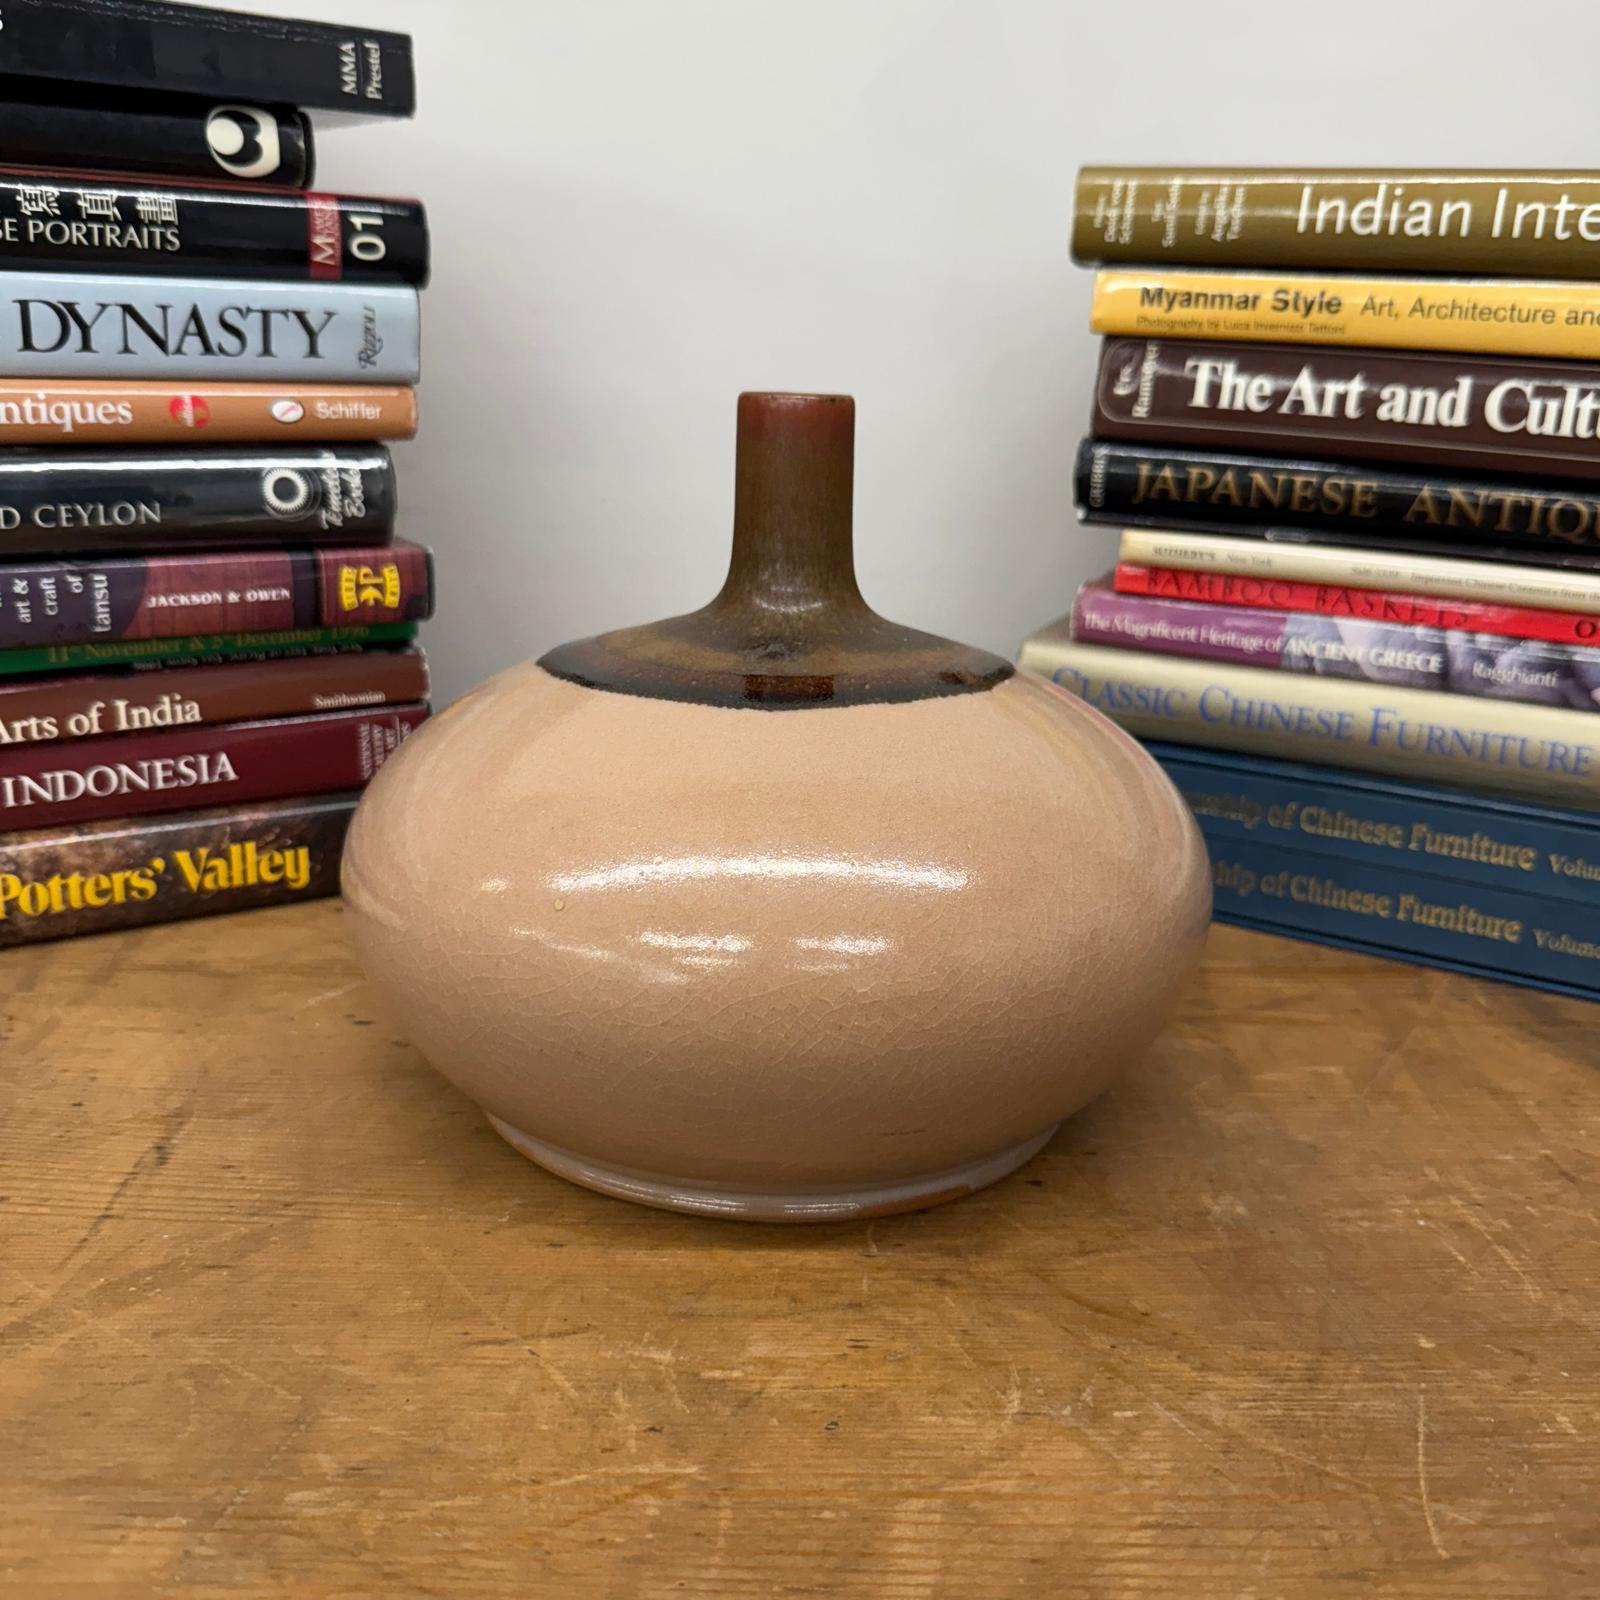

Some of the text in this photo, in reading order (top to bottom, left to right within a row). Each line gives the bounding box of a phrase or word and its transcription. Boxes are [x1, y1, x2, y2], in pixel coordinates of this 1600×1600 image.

[337, 41, 359, 96] MMA
[365, 39, 383, 100] Prestel
[28, 219, 181, 252] PORTRAITS
[347, 212, 387, 262] 01
[1227, 186, 1246, 242] Taschen
[1297, 183, 1600, 241] Indian Inte
[13, 299, 340, 359] DYNASTY
[1137, 315, 1203, 332] Photography
[1141, 287, 1259, 313] Myanmar
[1271, 288, 1343, 316] Style
[1360, 295, 1399, 320] Art,
[1408, 297, 1555, 326] Architecture
[314, 402, 383, 419] Schiffer
[1184, 358, 1600, 438] The Art and Cult
[34, 501, 162, 528] CEYLON
[1133, 463, 1600, 543] JAPANESE ANTIQ
[14, 578, 32, 624] art &
[40, 576, 57, 617] craft
[66, 574, 84, 594] of
[90, 574, 112, 633] tansu
[145, 587, 291, 609] JACKSON & OWEN
[85, 639, 182, 660] November
[1084, 613, 1444, 673] The Magnificent Heritage of ANCIENT GREECE
[313, 690, 386, 709] Smithsonian
[1472, 661, 1559, 688] Ragghianti
[66, 702, 105, 737] of
[115, 693, 202, 731] India
[1200, 684, 1354, 741] CHINESE
[1367, 706, 1593, 777] FURNITURE
[0, 751, 239, 808] INDONESIA
[1268, 801, 1298, 830] of
[1300, 805, 1403, 848] Chinese
[1408, 823, 1538, 872] Furniture
[172, 841, 310, 893] Valley
[1260, 872, 1290, 899] of
[1290, 875, 1390, 919] Chinese
[1396, 894, 1522, 944] Furniture
